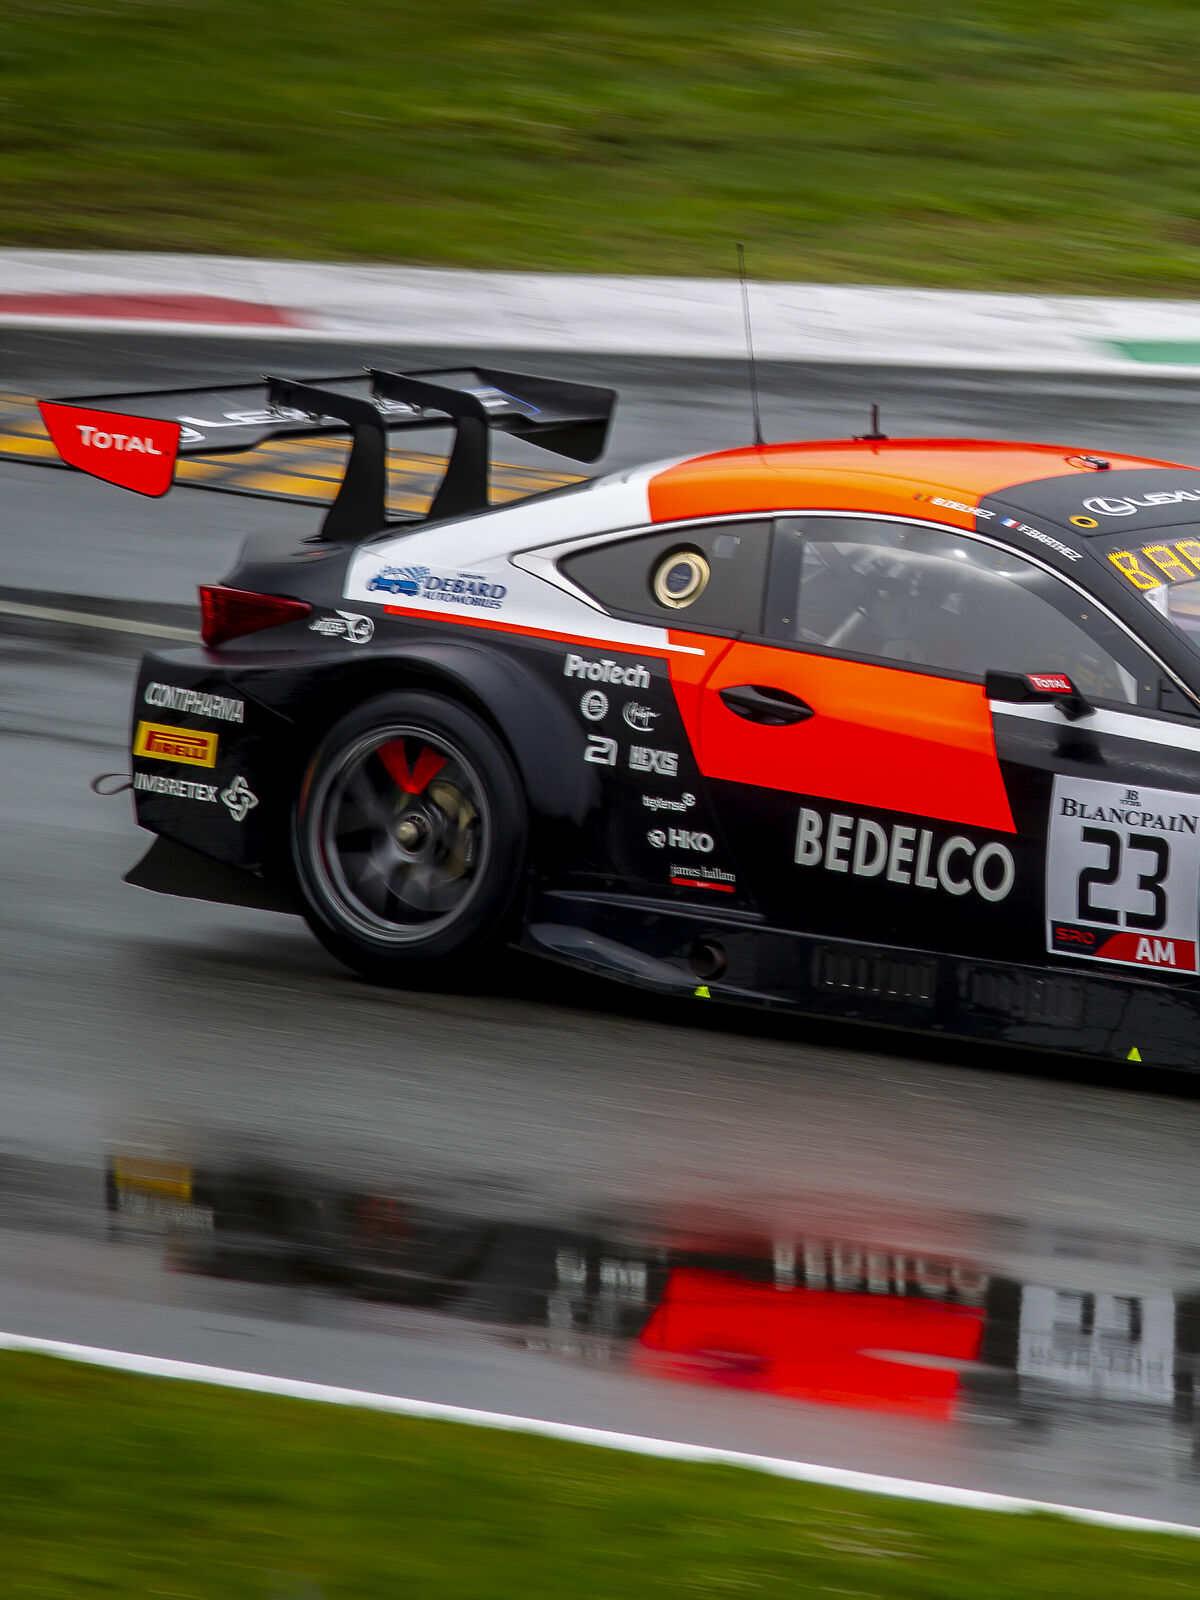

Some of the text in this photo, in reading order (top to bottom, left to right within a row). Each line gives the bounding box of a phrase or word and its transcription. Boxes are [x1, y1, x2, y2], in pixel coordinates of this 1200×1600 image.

[76, 424, 162, 455] TOTAL
[424, 576, 507, 599] DEBARD
[564, 653, 651, 689] ProTech
[1030, 677, 1071, 689] TOTAL
[144, 682, 244, 724] CONTIPHARMA
[145, 730, 210, 761] PIRELLI
[1060, 797, 1200, 835] BLANCPAIN
[668, 827, 714, 853] HKO
[794, 807, 1016, 902] BEDELCO
[1076, 825, 1171, 931] 23
[1055, 928, 1177, 966] SRO AM
